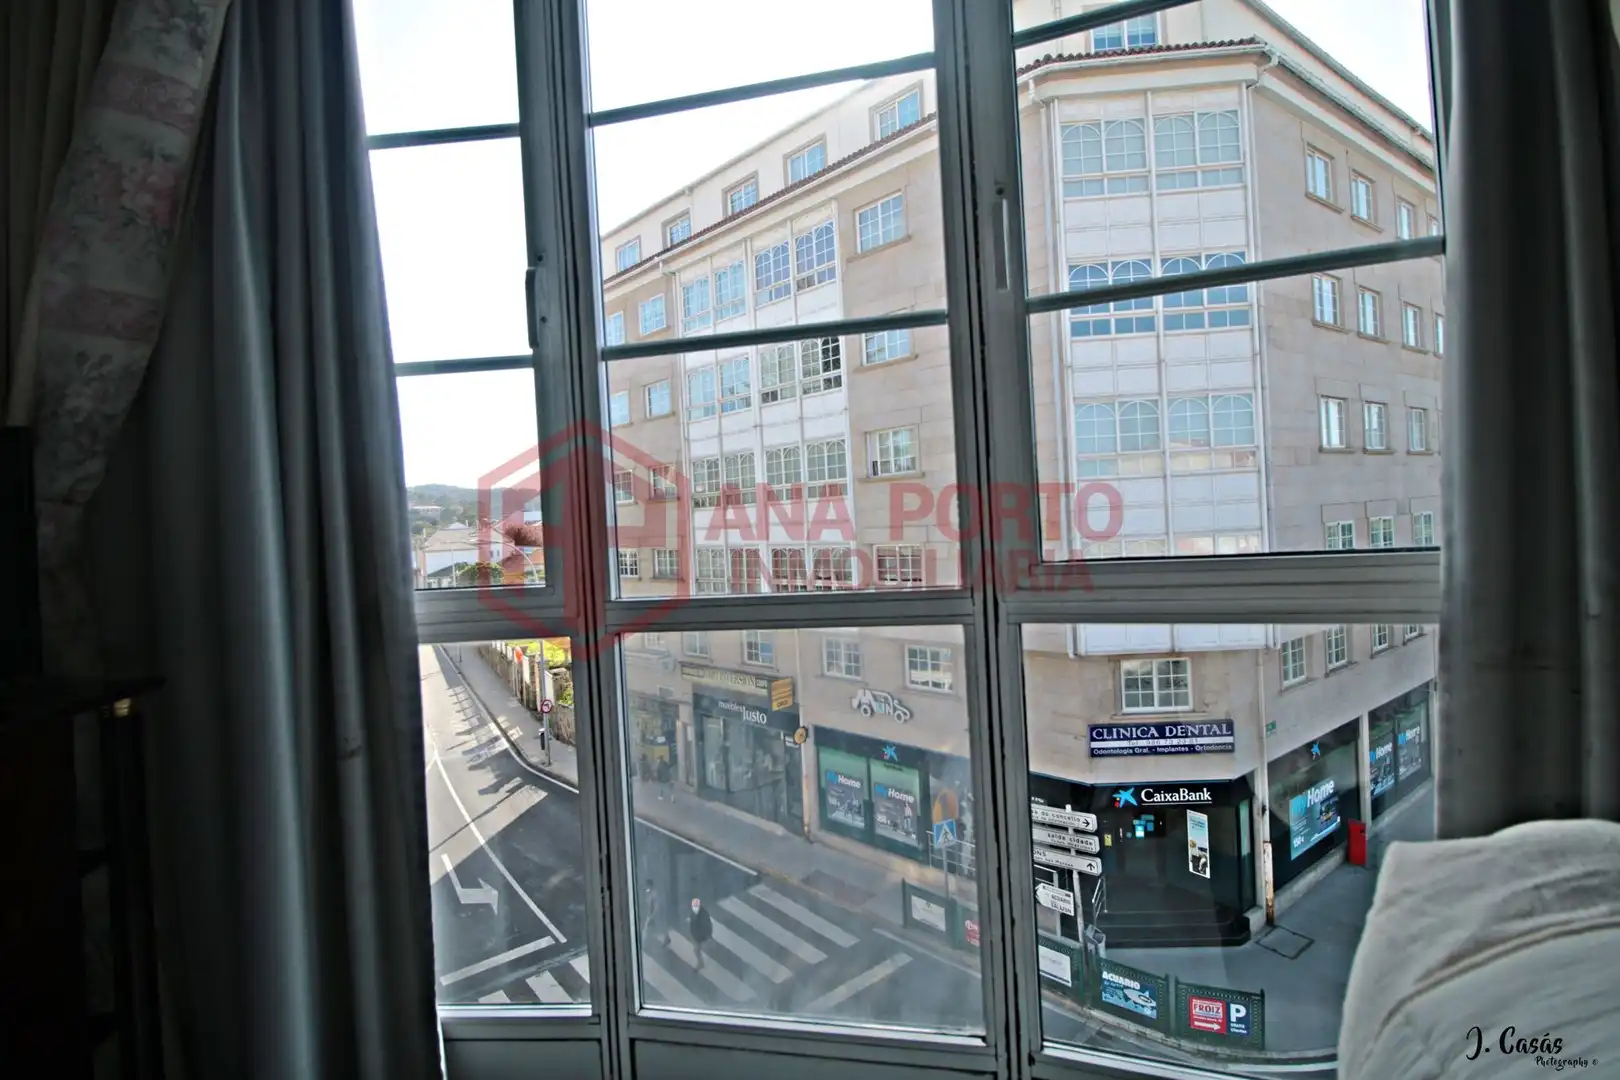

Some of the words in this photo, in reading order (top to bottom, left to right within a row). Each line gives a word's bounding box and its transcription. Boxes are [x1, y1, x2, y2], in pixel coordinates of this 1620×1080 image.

[1092, 725, 1159, 740] CLINICA
[1164, 723, 1231, 738] DENTAL
[1156, 745, 1190, 754] Implantes
[1376, 742, 1392, 759] Home
[838, 775, 860, 788] Home
[888, 789, 914, 803] Home
[1141, 787, 1212, 803] CaixaBank
[1307, 780, 1334, 807] Home
[1052, 812, 1081, 823] concello
[1069, 837, 1094, 847] cidade
[1102, 971, 1140, 990] ACUARIO
[1194, 1004, 1221, 1014] FROIZ
[1230, 1003, 1247, 1022] P
